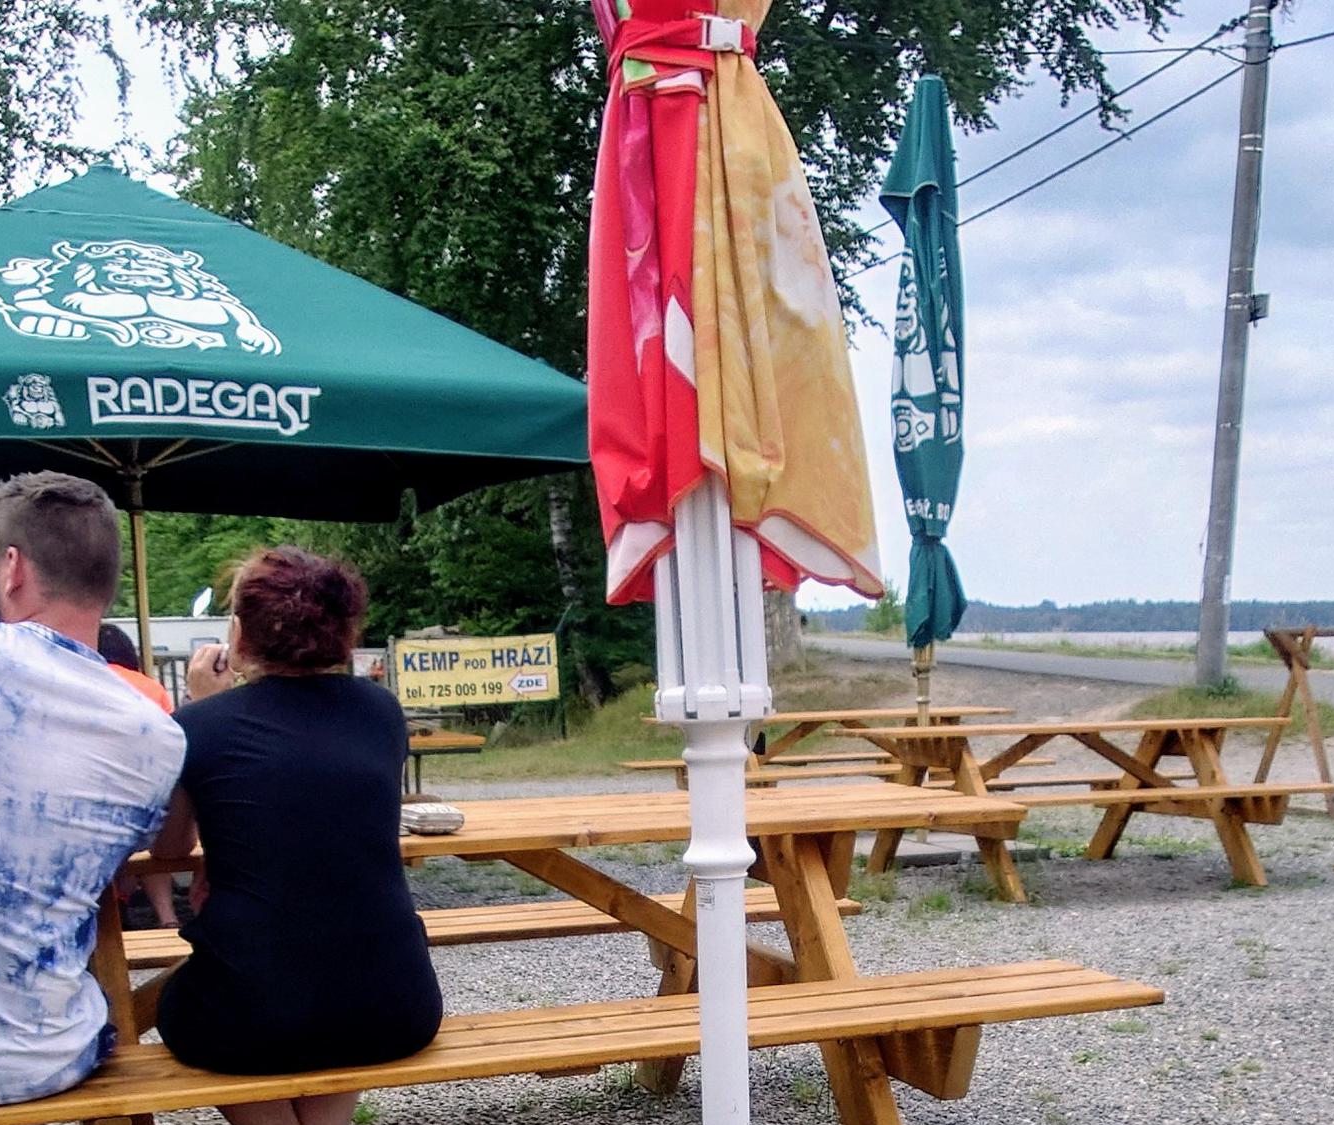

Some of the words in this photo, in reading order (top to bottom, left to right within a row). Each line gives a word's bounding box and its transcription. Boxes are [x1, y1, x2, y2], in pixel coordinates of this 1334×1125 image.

[87, 376, 322, 436] RADEGAST
[403, 651, 460, 673] KEMP
[464, 658, 487, 670] POD
[491, 640, 552, 669] HRÁZÍ
[406, 685, 426, 699] tel.
[429, 684, 452, 698] 725
[455, 683, 477, 697] 009
[481, 681, 503, 695] 199
[517, 678, 543, 689] ZDE
